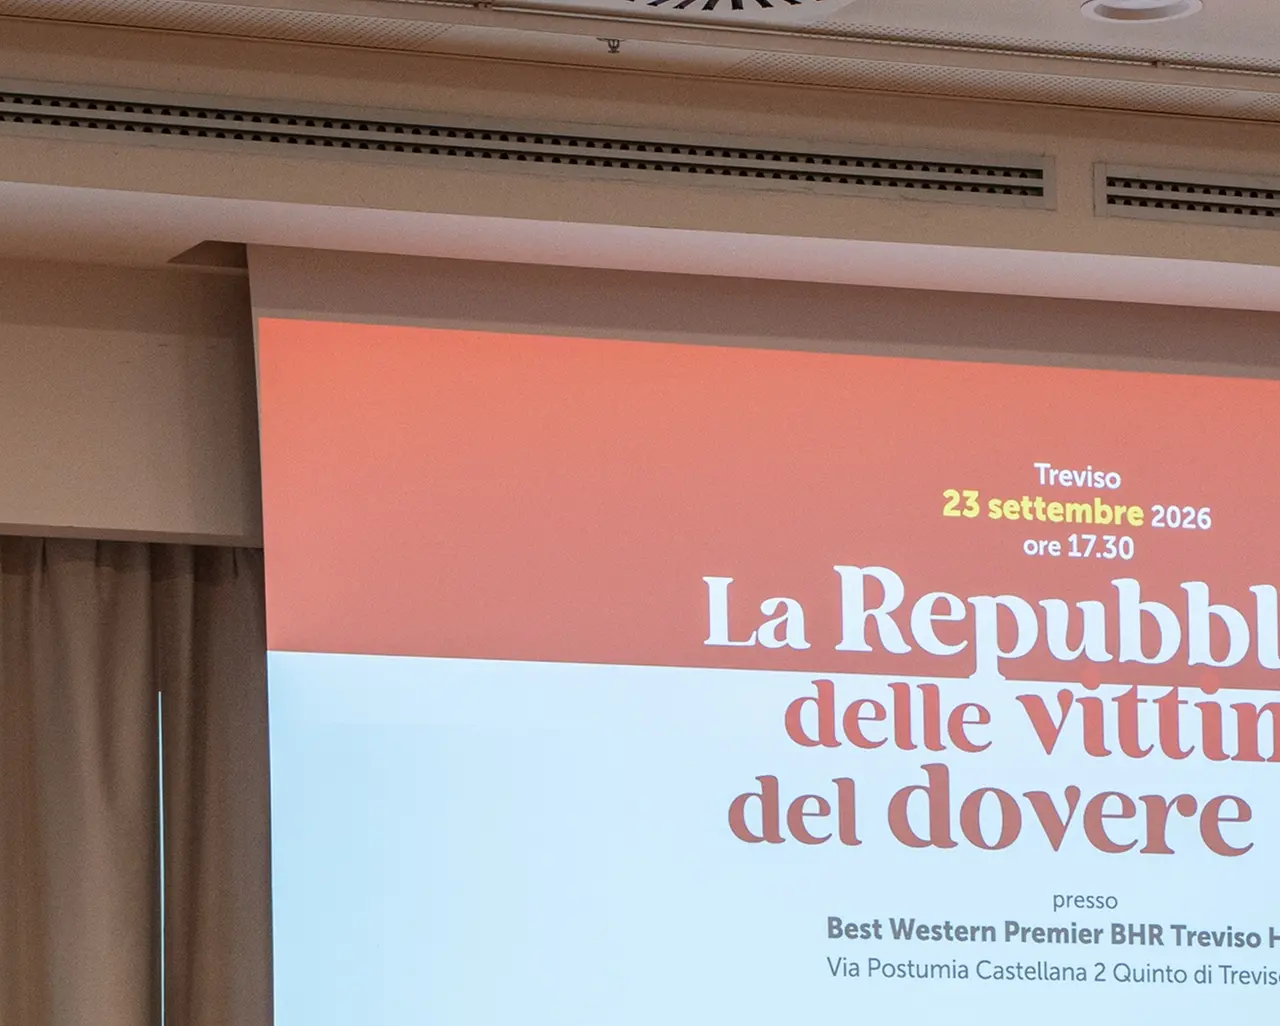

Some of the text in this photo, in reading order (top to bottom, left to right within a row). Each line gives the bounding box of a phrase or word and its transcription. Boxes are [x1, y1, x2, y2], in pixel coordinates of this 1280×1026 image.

[1033, 462, 1122, 491] Treviso
[942, 489, 1212, 530] 23 settembre 2026
[1023, 534, 1135, 560] ore 17.30
[703, 576, 810, 651] La
[784, 679, 992, 753] delle
[728, 763, 1255, 857] del dovere
[1053, 891, 1118, 912] presso
[827, 916, 883, 941] Best
[889, 918, 997, 944] Western
[1004, 921, 1104, 945] Premier
[1110, 924, 1164, 947] BHR
[1170, 923, 1262, 948] Treviso
[826, 957, 861, 978] Via
[867, 958, 970, 980] Postumia
[975, 959, 1088, 983] Castellana
[1093, 962, 1107, 983] 2
[1113, 962, 1188, 985] Quinto
[1194, 963, 1213, 985] di
